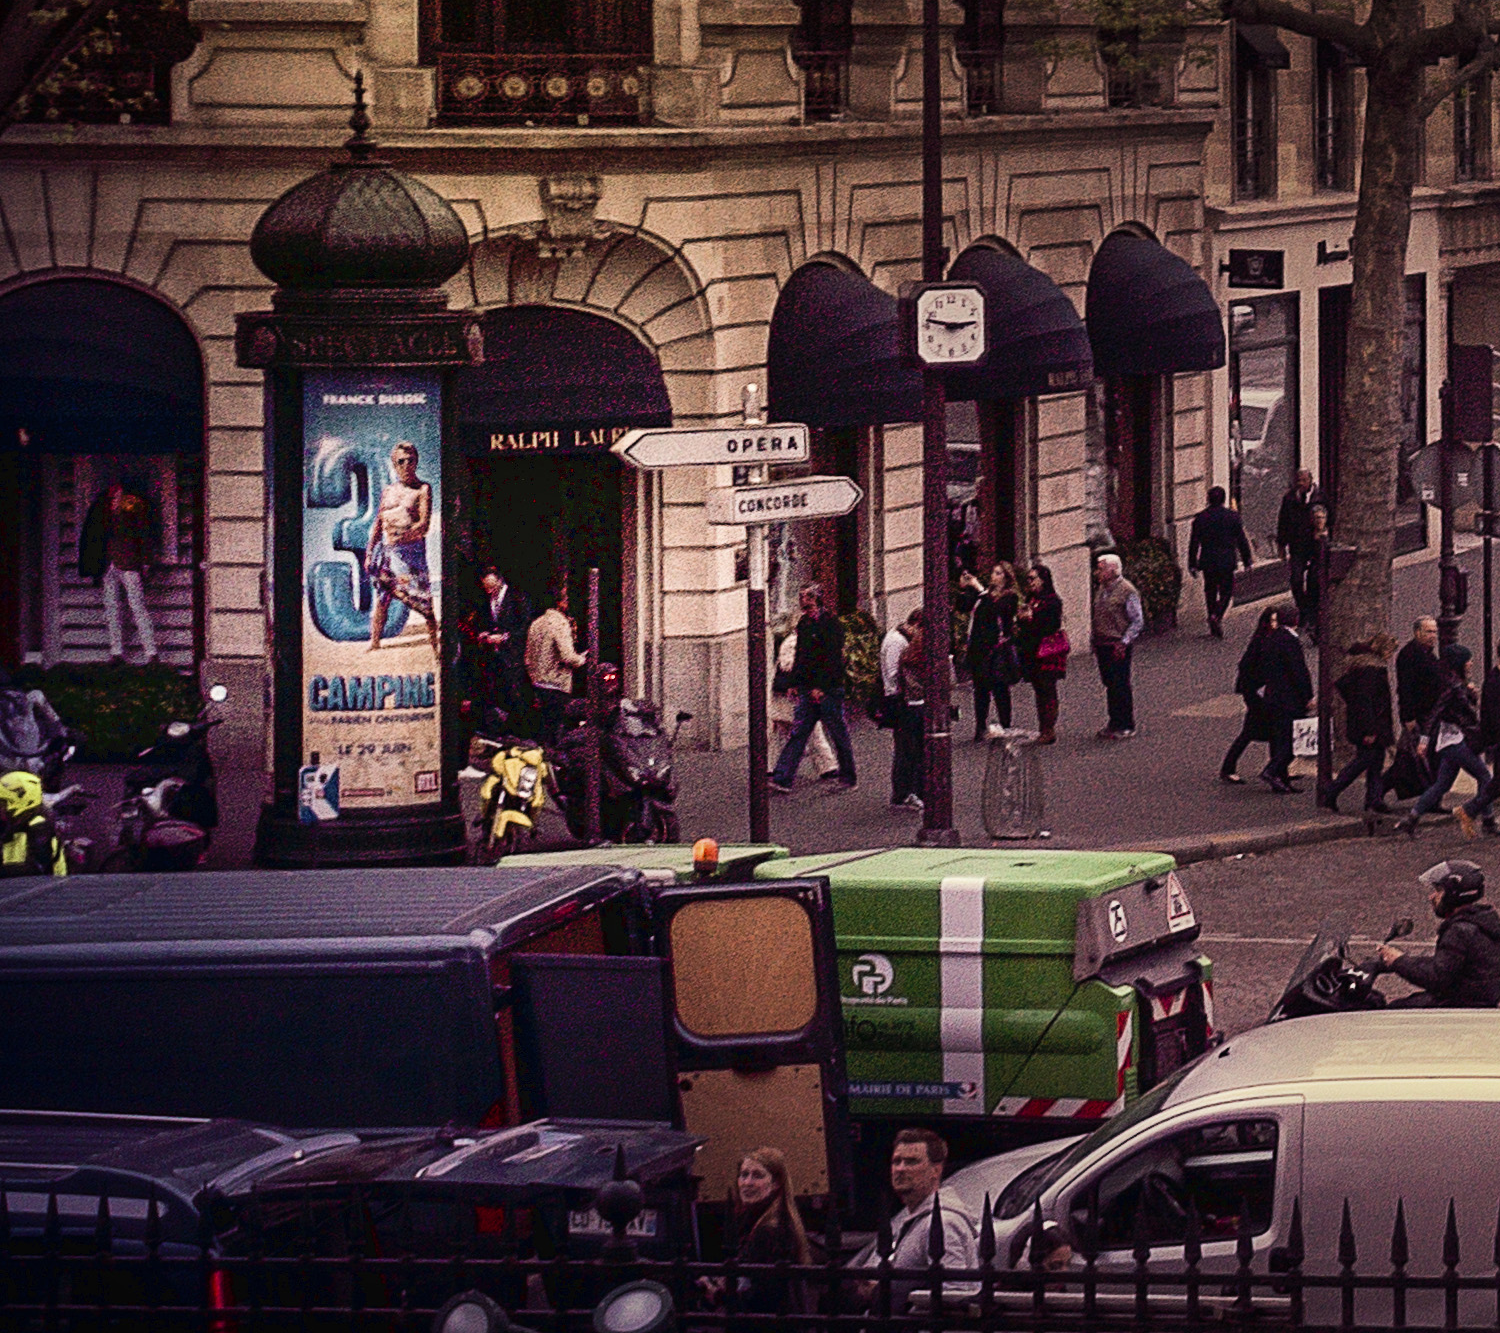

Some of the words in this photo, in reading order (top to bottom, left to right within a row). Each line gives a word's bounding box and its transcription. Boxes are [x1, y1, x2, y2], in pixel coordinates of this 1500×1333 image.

[490, 431, 560, 451] RALPH
[727, 436, 798, 454] OPERA
[738, 493, 808, 514] CONCORDE
[310, 672, 436, 711] CAMPING
[896, 1084, 911, 1095] DE
[916, 1084, 950, 1095] PARIS
